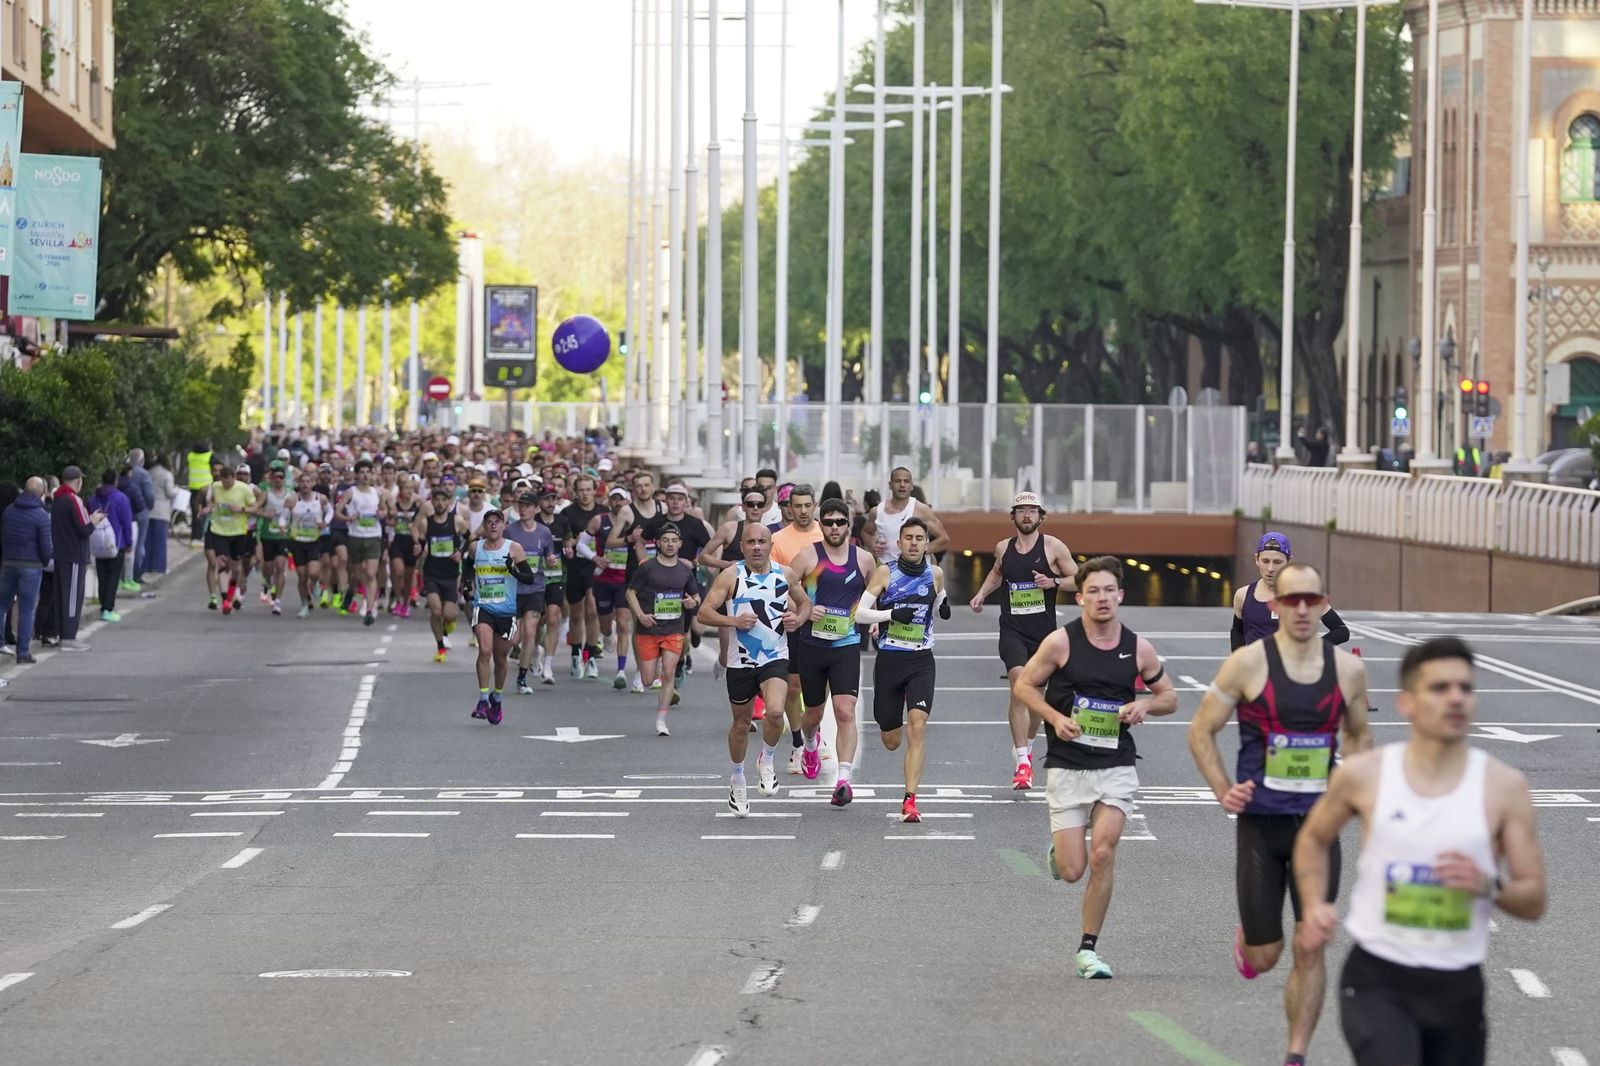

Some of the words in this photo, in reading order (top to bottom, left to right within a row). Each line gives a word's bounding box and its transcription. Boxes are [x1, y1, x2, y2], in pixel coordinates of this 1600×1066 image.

[31, 220, 65, 230] ZURICH
[29, 238, 65, 248] SEVILLA
[822, 624, 837, 633] ASA
[1088, 727, 1118, 737] TITOUAN
[1291, 737, 1326, 746] ZURICH
[1286, 766, 1311, 777] ROB
